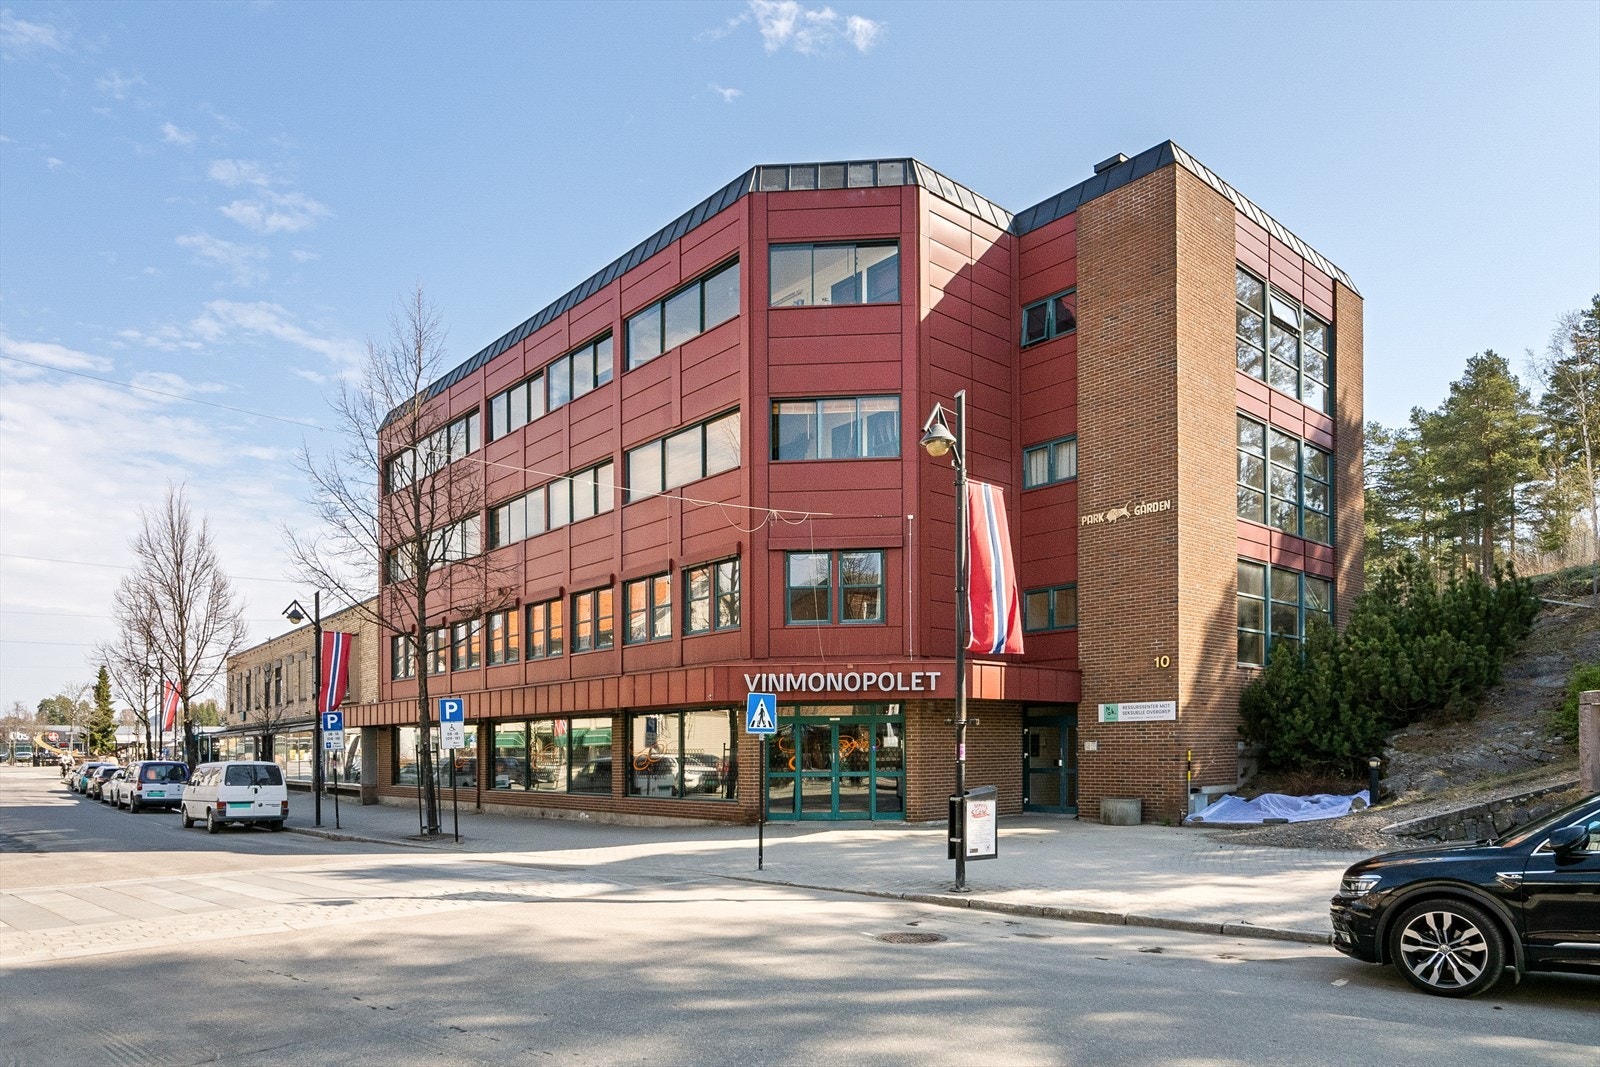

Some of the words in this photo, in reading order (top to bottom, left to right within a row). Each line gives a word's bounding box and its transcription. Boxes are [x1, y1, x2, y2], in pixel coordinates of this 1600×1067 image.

[1081, 512, 1104, 525] PARK
[1134, 499, 1171, 516] GÅRDEN
[1154, 656, 1170, 668] 10
[744, 672, 941, 692] VINMONOPOLET
[445, 701, 458, 720] P
[327, 714, 338, 729] P
